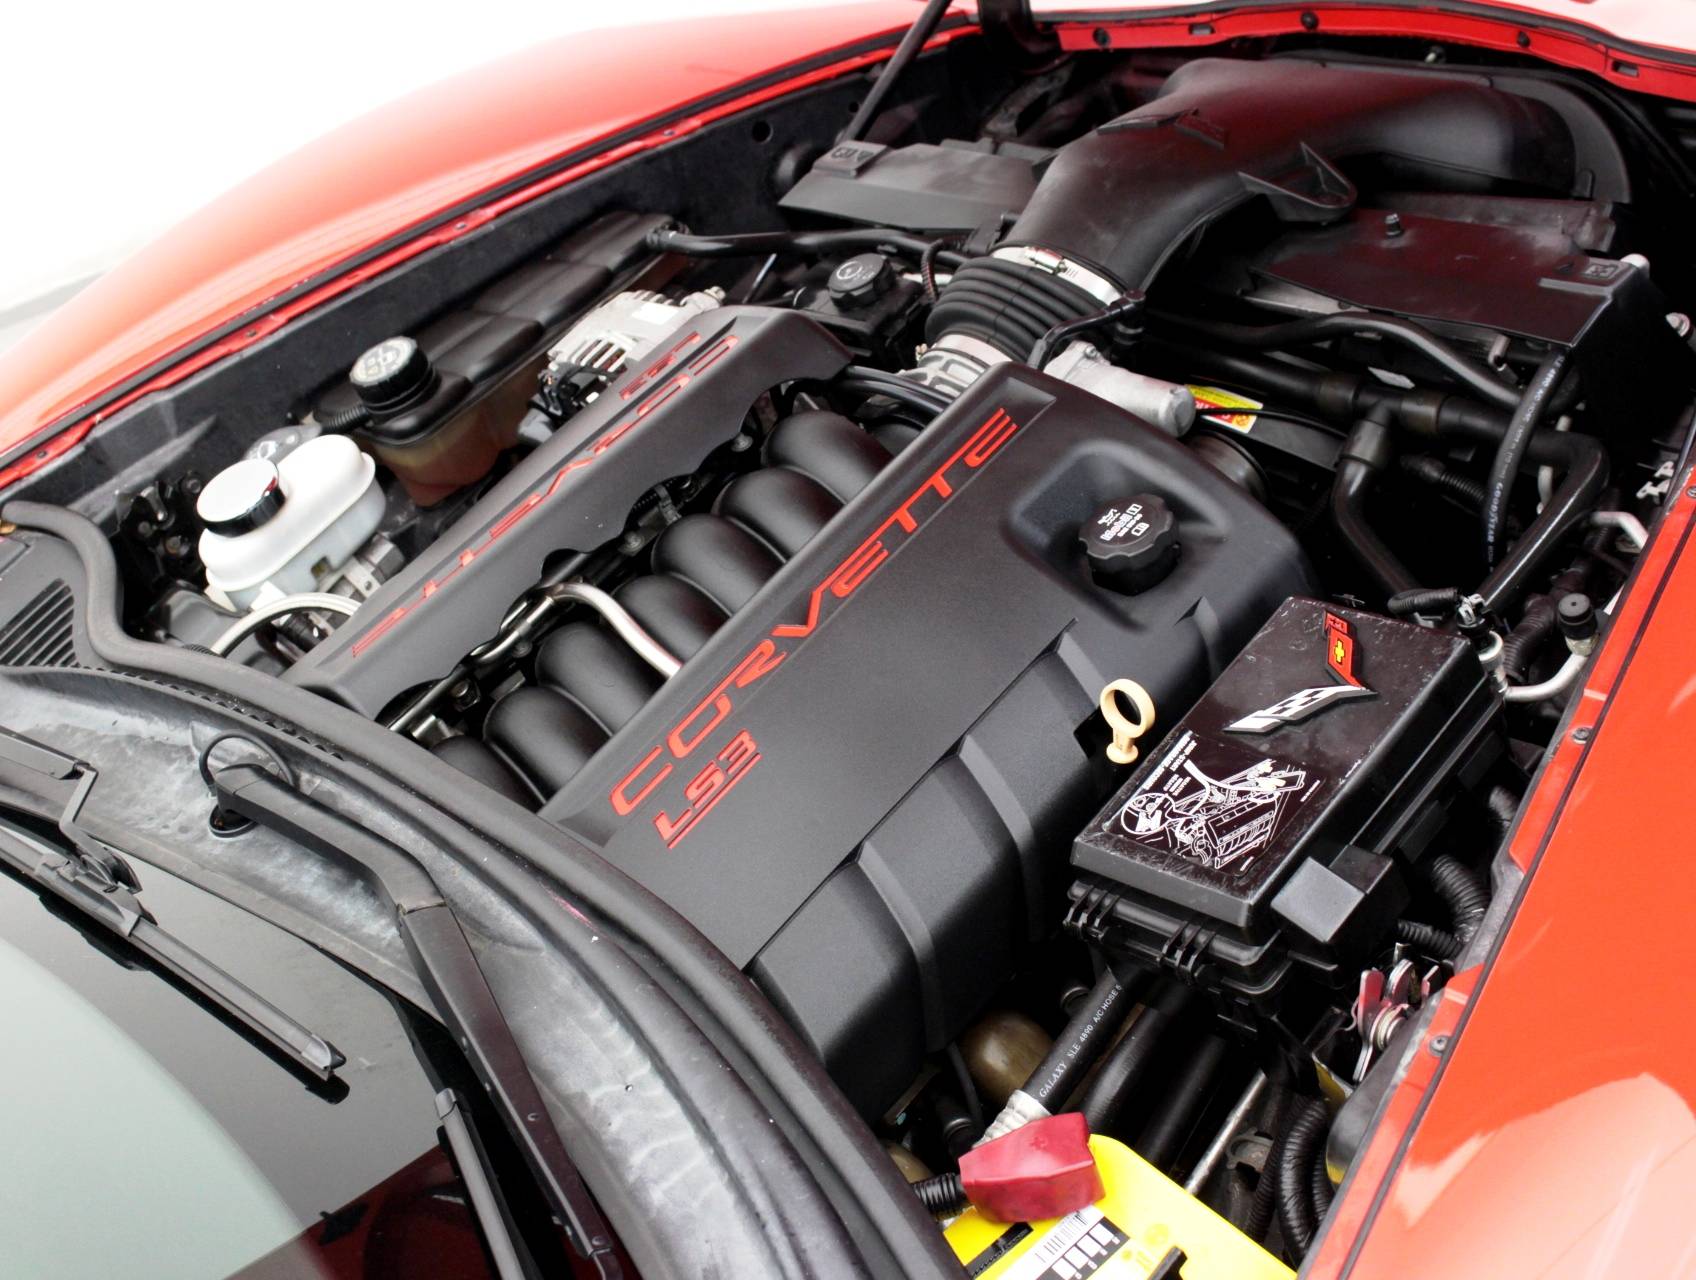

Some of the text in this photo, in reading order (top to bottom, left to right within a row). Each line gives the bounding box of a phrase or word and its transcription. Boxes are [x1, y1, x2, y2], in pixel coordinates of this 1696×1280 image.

[352, 335, 739, 658] CORVETTE
[608, 407, 1019, 817] CORVETTE
[652, 728, 762, 848] LS3
[1040, 1060, 1067, 1098] GALAXY
[1066, 1042, 1081, 1059] SLE
[1079, 1024, 1094, 1042] 4890
[1093, 1009, 1104, 1023] A/C
[1101, 989, 1119, 1010] HOSE
